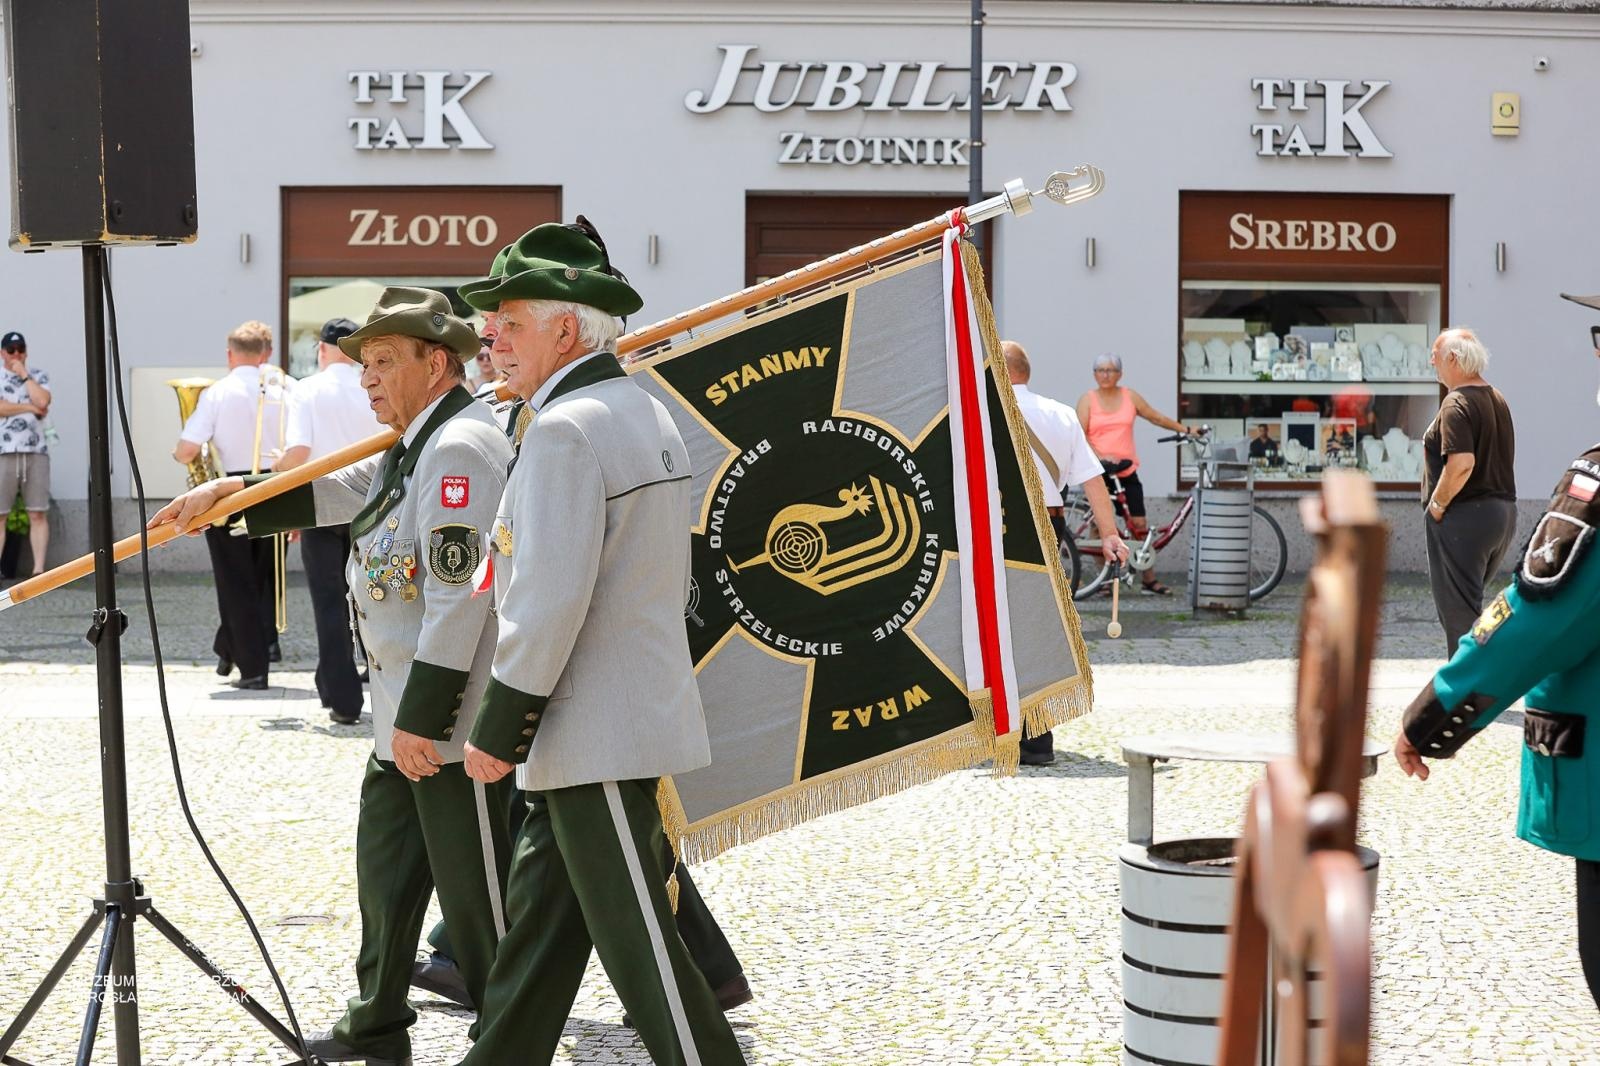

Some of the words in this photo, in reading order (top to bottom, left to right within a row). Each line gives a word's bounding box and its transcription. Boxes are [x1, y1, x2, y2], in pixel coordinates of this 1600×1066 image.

[684, 43, 1079, 114] JUBILER
[777, 131, 970, 167] ZŁOTNIK
[347, 208, 498, 247] ZŁOTO
[1229, 213, 1397, 253] SREBRO
[709, 438, 773, 550] BRACTWO
[802, 418, 935, 514] RACIBORSKIE
[715, 568, 844, 656] STRZELECKIE
[872, 533, 940, 643] KURKOWE
